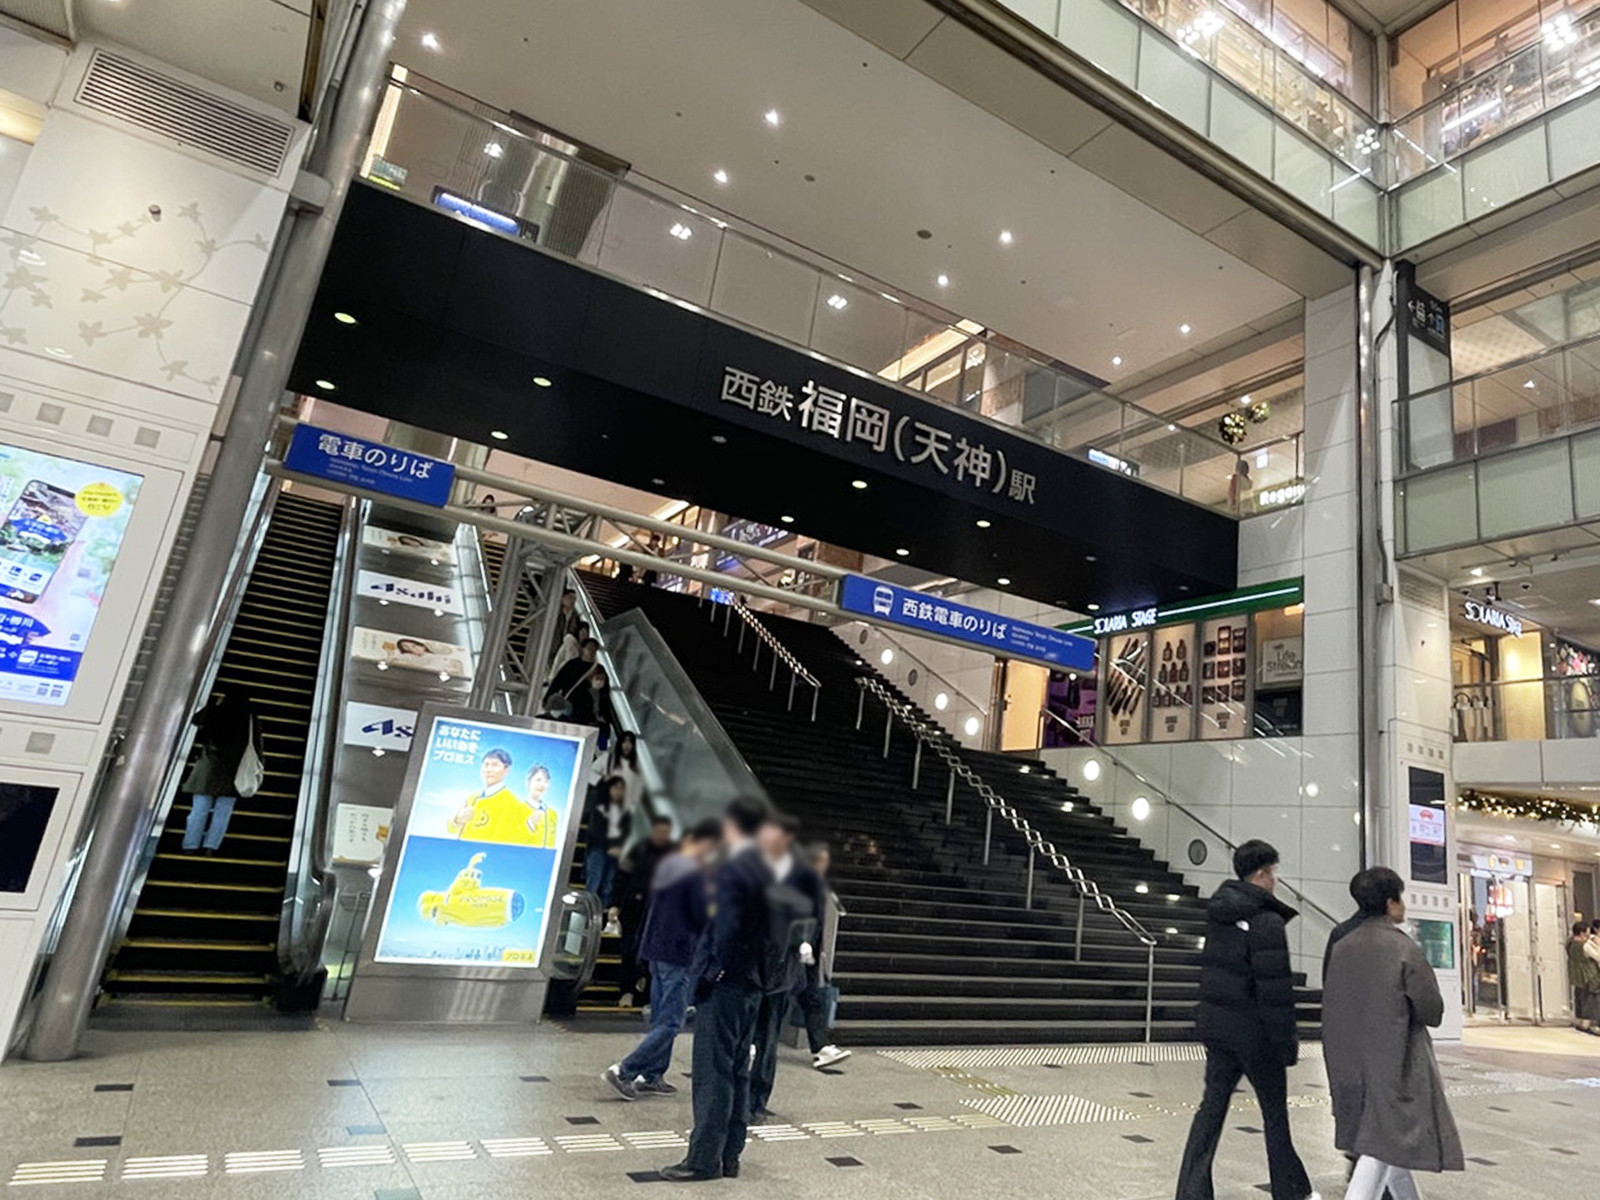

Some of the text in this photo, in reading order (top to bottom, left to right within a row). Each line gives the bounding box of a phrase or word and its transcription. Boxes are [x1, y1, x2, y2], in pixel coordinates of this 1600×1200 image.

[318, 433, 434, 479] 電車のりば
[721, 366, 1037, 505] 西鉄福岡(天神)駅
[902, 597, 1008, 640] 西鉄電車のりば
[438, 724, 482, 741] あなたに
[433, 749, 475, 765] プロミス
